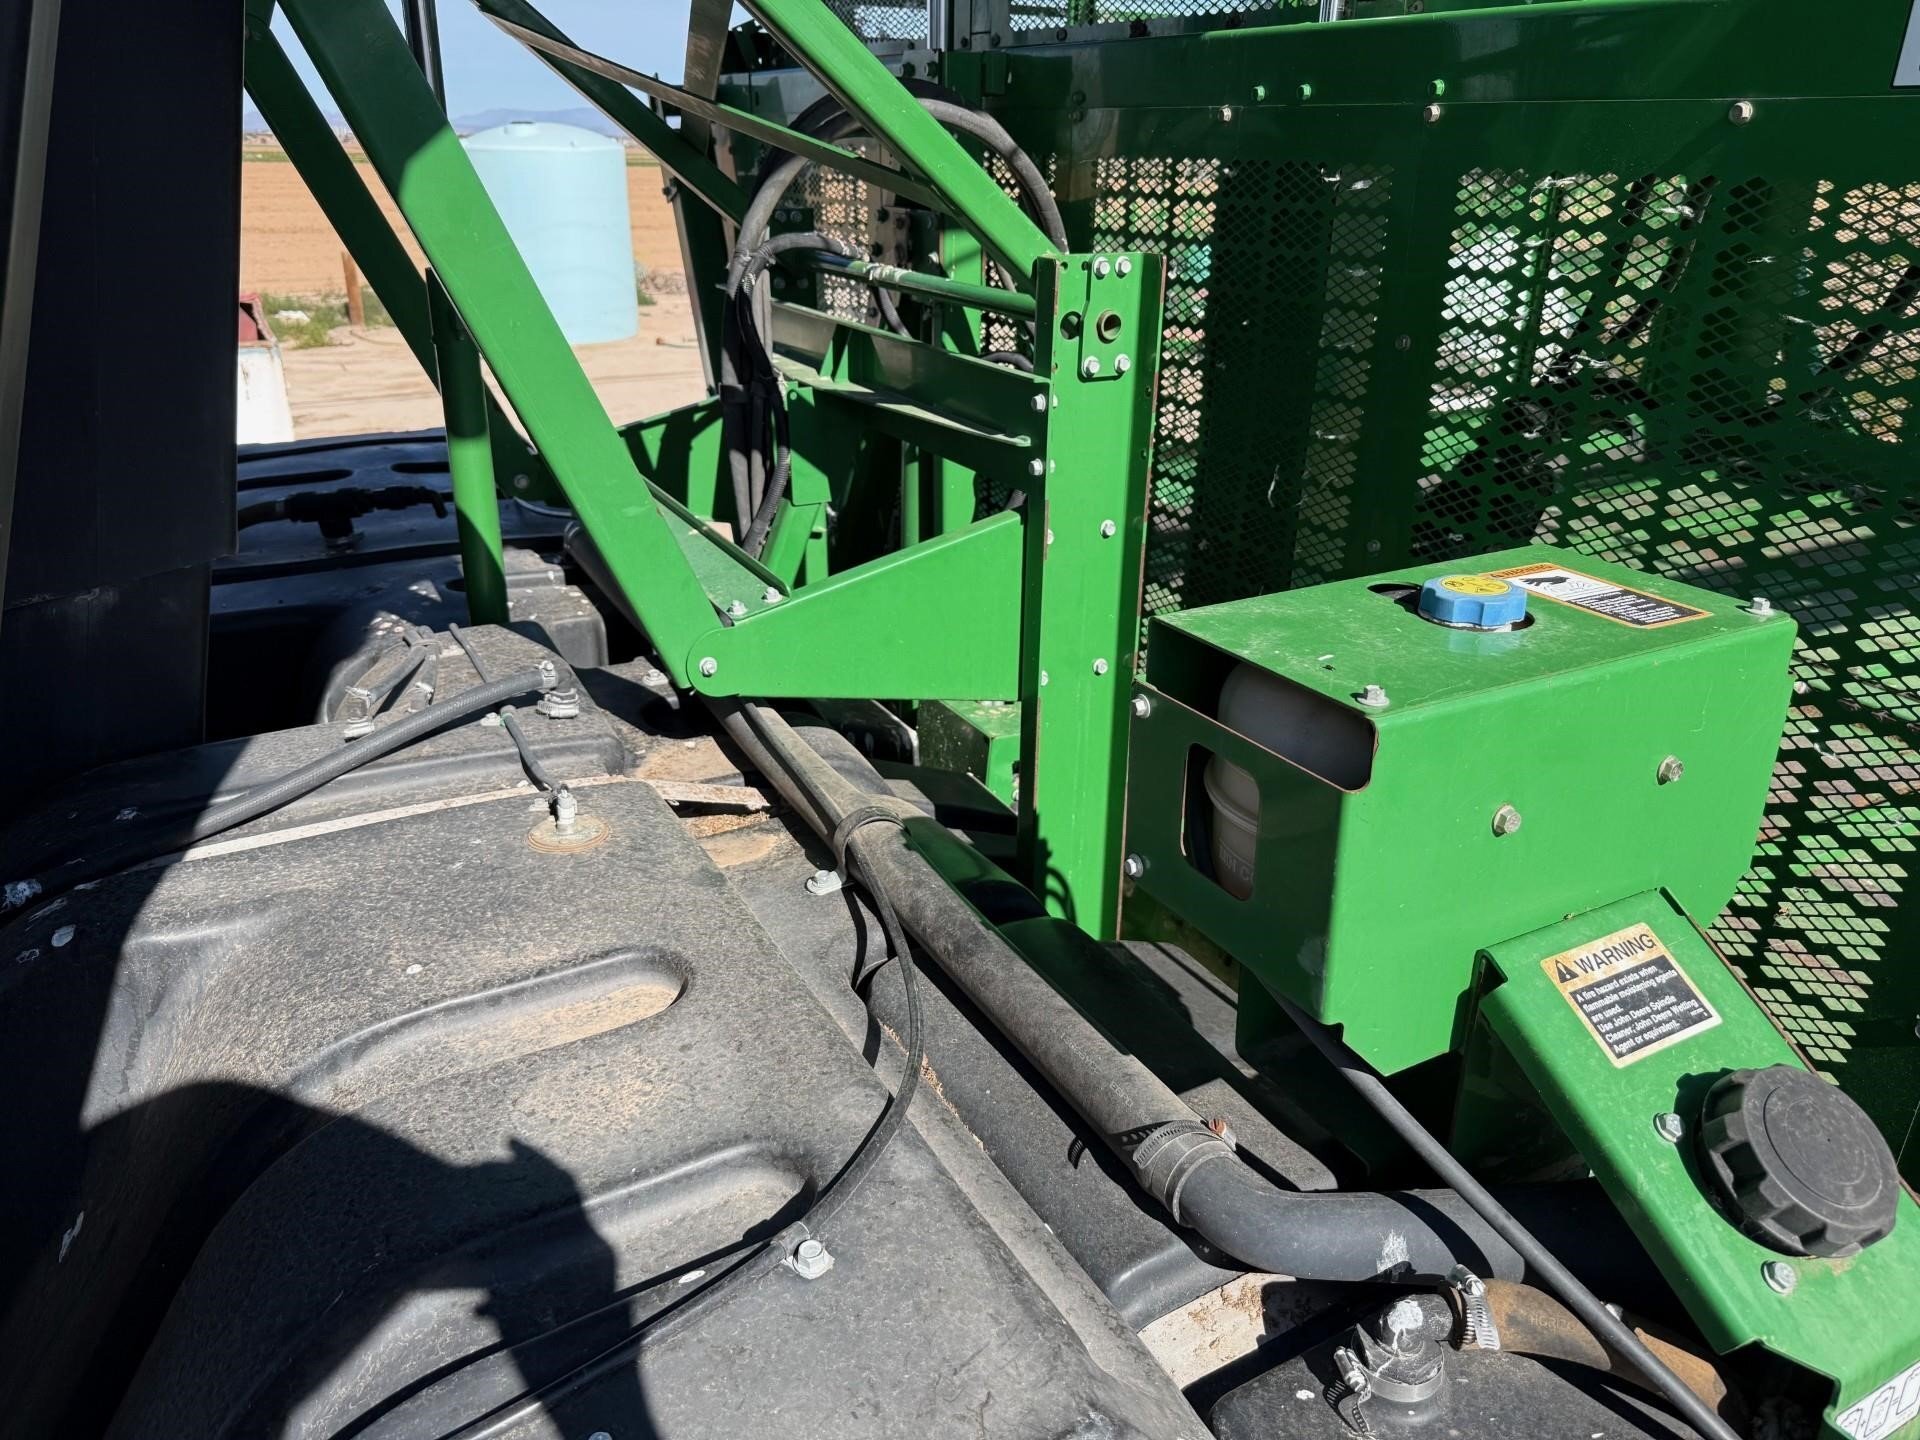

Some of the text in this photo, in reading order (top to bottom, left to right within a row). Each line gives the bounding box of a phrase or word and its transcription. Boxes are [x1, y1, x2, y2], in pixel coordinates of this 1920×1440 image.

[1574, 933, 1657, 974] WARNING
[1576, 965, 1658, 1003] A fire hazard exists when
[1582, 969, 1678, 1013] flammable moistening agents
[1590, 1004, 1624, 1023] are used.
[1596, 994, 1677, 1033] Use John Deere Spindle
[1634, 1018, 1654, 1031] John
[1650, 1009, 1673, 1023] Deere
[1669, 999, 1699, 1015] Wetting
[1613, 1019, 1680, 1054] Agent or equivalent.
